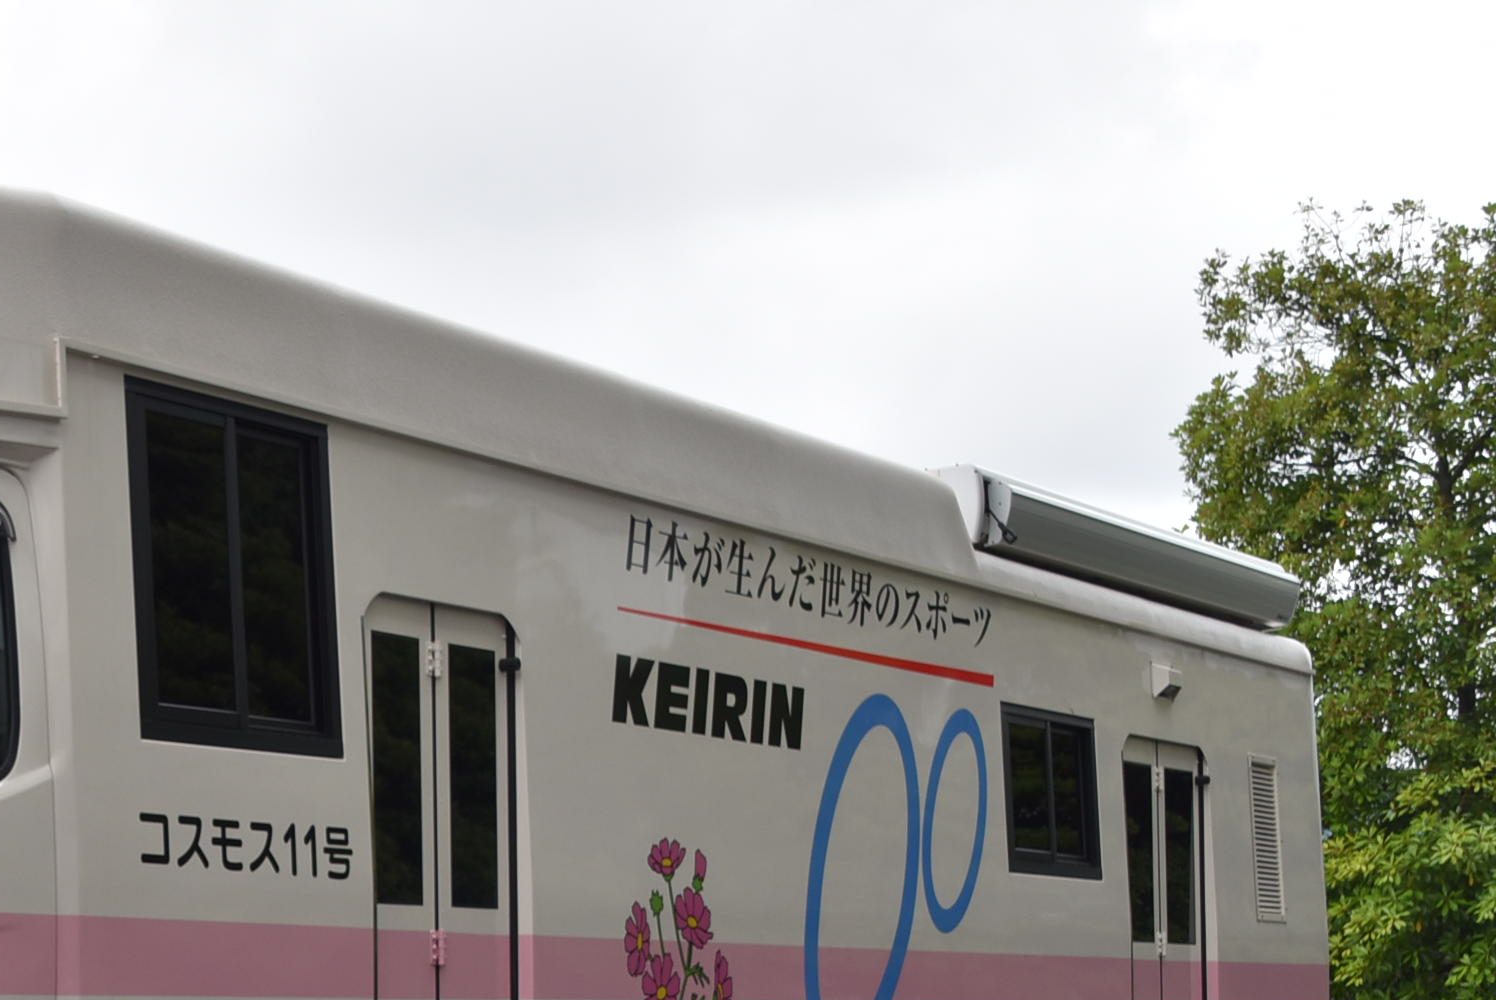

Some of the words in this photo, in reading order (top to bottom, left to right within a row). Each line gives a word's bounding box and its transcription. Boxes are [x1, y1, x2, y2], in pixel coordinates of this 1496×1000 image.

[626, 514, 991, 647] 日本が生んだ世界のスポーツ
[612, 653, 804, 751] KEIRIN
[139, 812, 353, 880] コスモス11号
